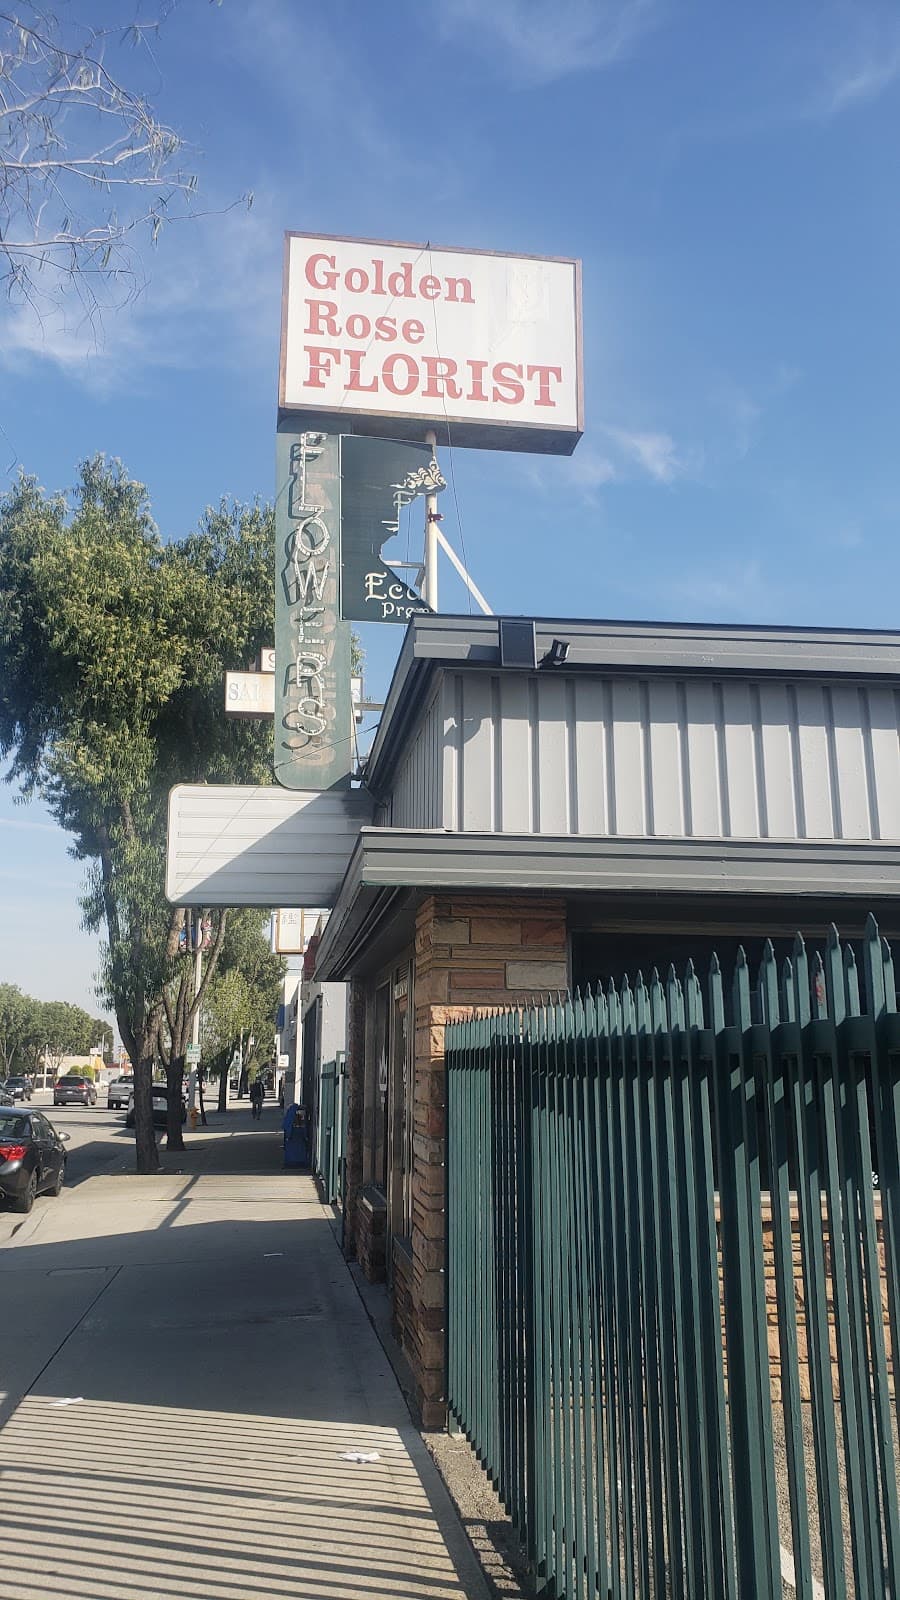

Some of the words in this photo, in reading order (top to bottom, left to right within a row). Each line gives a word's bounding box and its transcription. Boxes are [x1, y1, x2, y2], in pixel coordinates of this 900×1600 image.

[304, 253, 476, 304] Golden
[303, 299, 425, 344] Rose
[302, 345, 562, 407] FLORIST
[294, 431, 331, 736] FLOWERS
